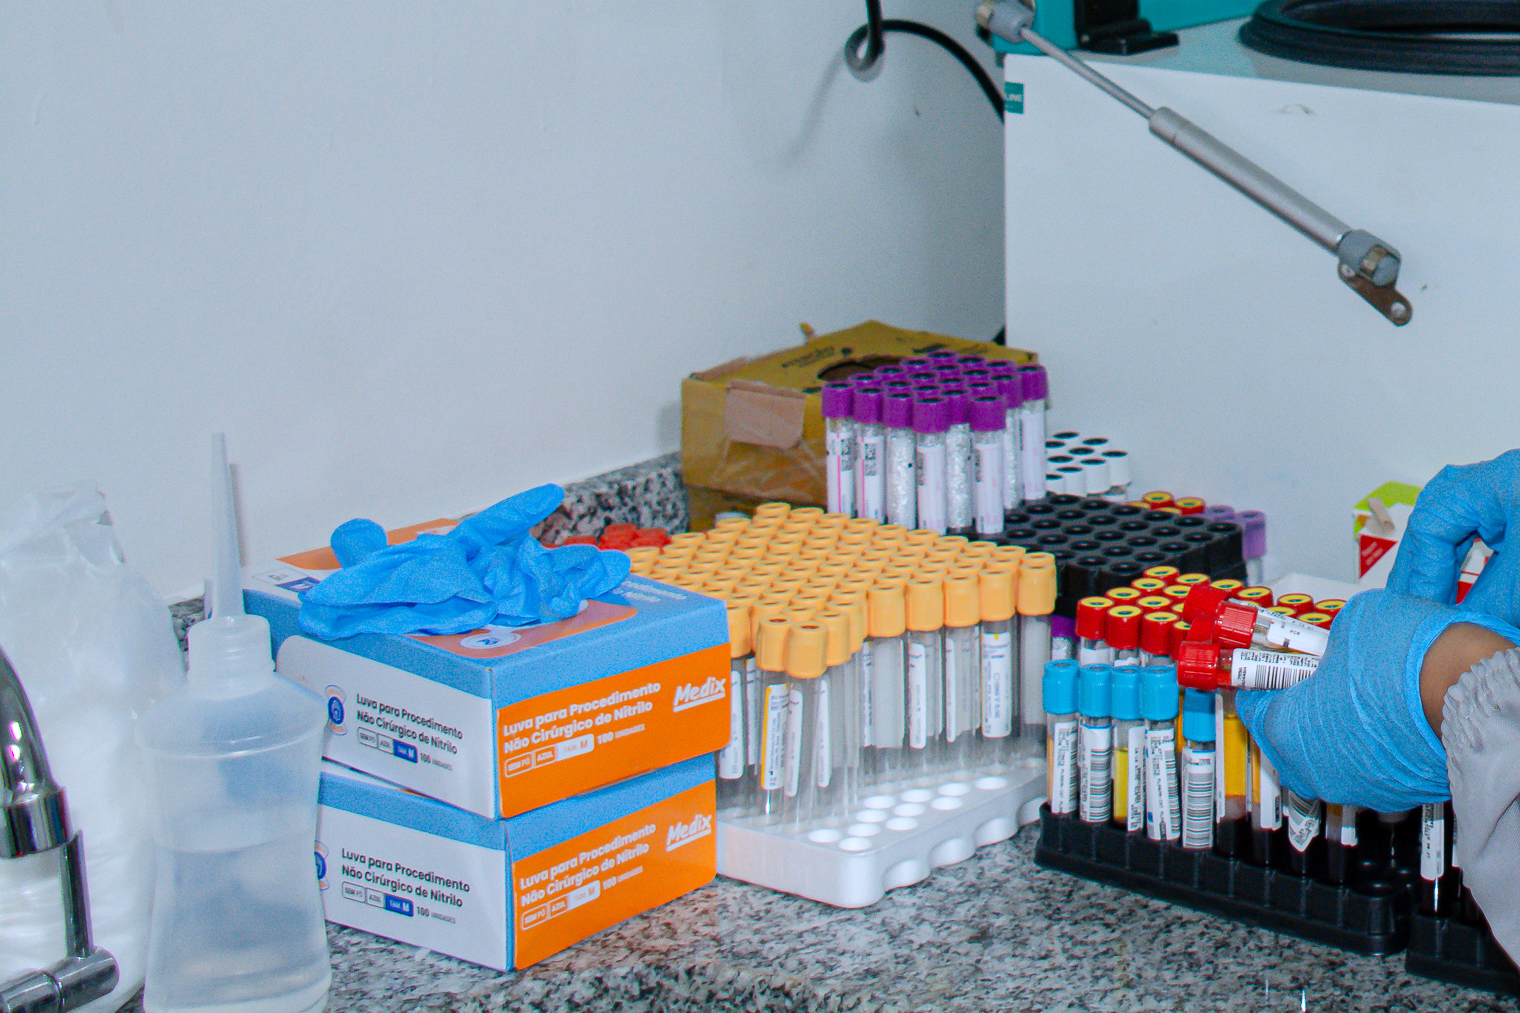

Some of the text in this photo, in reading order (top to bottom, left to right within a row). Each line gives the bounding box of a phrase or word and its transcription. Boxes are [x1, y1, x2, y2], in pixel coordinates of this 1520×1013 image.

[503, 682, 661, 737] Luva para Procedimento
[673, 676, 727, 707] Medix
[356, 693, 378, 709] Luva
[379, 702, 401, 717] para
[401, 708, 463, 740] Procedimento
[357, 710, 458, 754] Não Cirúrgico de Nitrilo
[503, 701, 653, 754] Não Cirúrgico de Nitrilo
[579, 739, 589, 750] M
[596, 731, 614, 745] 100
[666, 813, 713, 848] Medix
[341, 847, 471, 893] Luva para Procedimento
[519, 824, 657, 891] Luva para Procedimento
[520, 843, 650, 907] Não Cirúrgico de Nitrilo
[342, 864, 463, 908] Não Cirúrgico de Nitrilo
[601, 876, 617, 891] 100
[402, 901, 411, 913] M
[416, 906, 430, 917] 100
